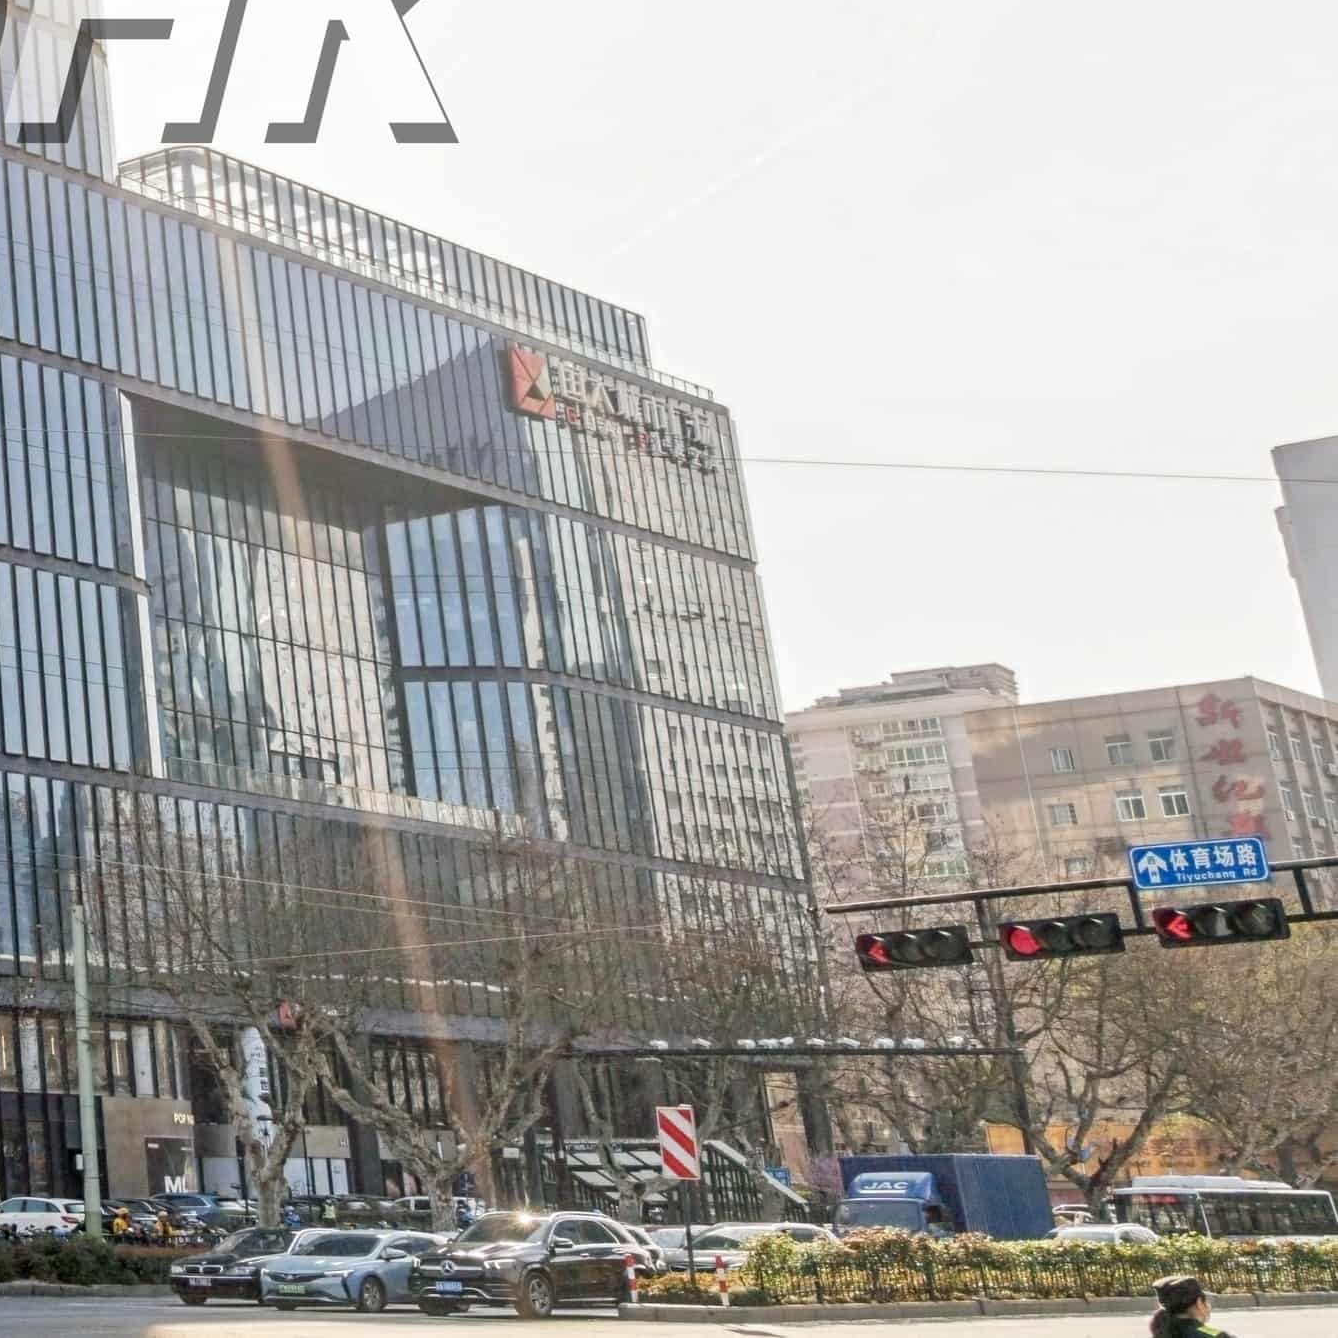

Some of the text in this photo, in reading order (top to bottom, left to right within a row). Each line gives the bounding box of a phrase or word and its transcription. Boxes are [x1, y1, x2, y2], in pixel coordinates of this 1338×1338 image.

[1169, 843, 1258, 872] 体育场路
[1176, 867, 1258, 883] Tiyuchang Rd
[864, 1181, 909, 1190] JAC
